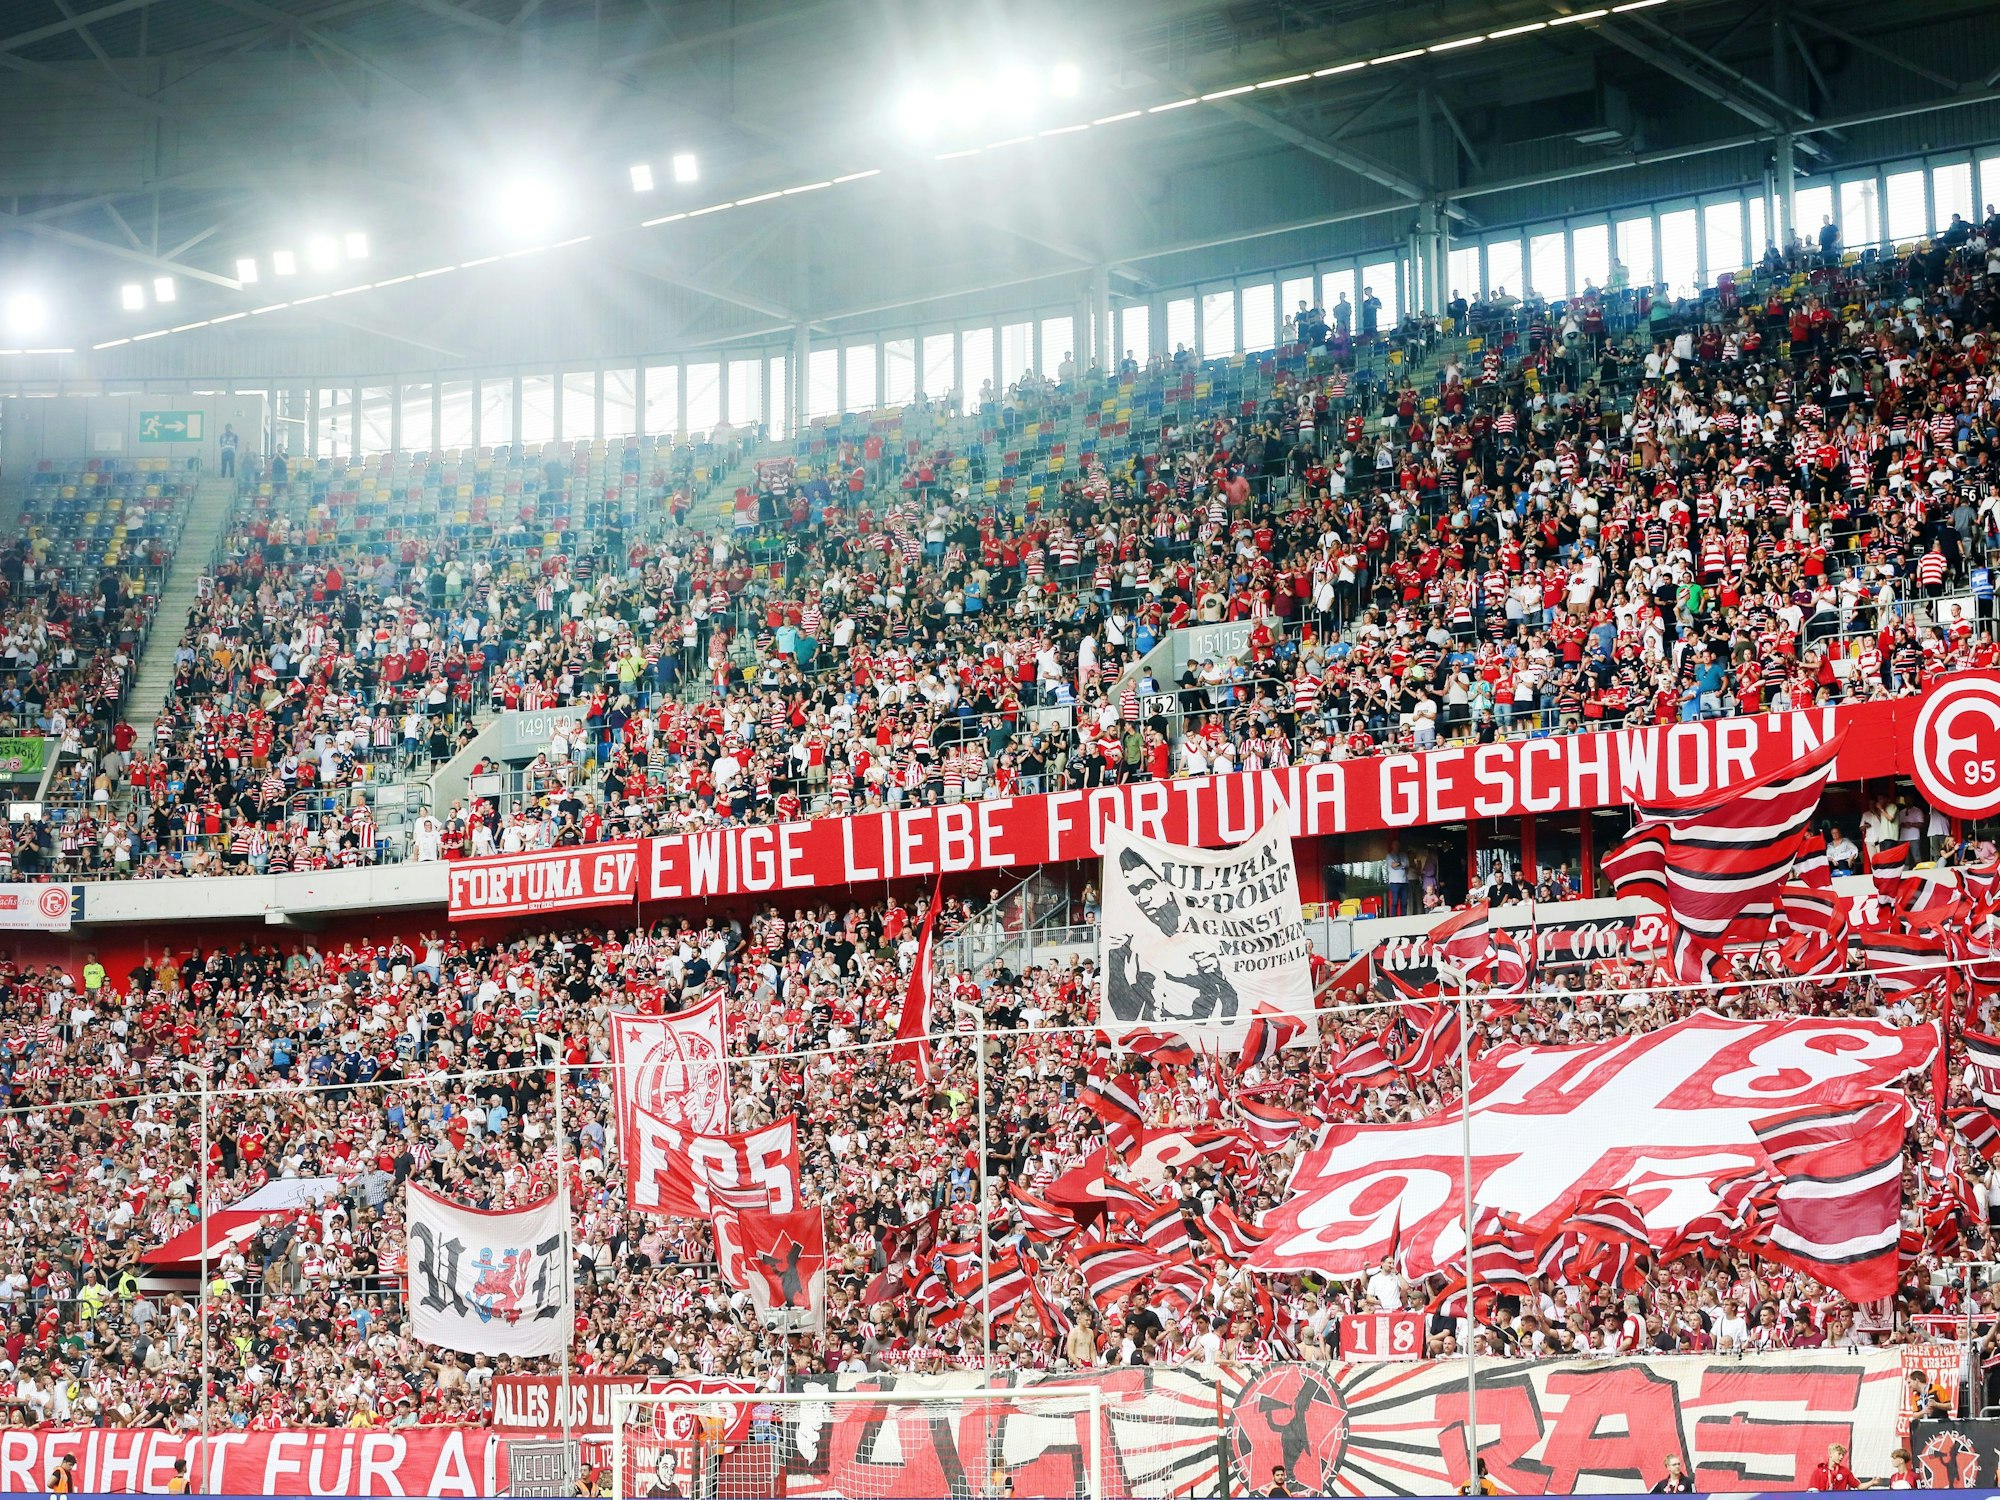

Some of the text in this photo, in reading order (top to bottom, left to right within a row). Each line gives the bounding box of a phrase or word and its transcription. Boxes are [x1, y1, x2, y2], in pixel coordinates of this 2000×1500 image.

[1961, 489, 1977, 502] 56
[1196, 629, 1248, 654] 151 152
[519, 715, 571, 737] 149 10
[1964, 760, 1996, 785] 95
[651, 822, 815, 900] EWIGE
[842, 800, 1015, 883] LIEBE
[1046, 763, 1346, 862] FORTUNA
[450, 852, 637, 909] FORTUNA GV
[1182, 907, 1284, 937] AGAINST
[1219, 919, 1306, 957] MODERN
[1570, 920, 1625, 961] 06
[493, 1383, 549, 1427] ALLES
[553, 1384, 588, 1427] AUS
[1925, 1430, 1974, 1448] ULTRAS
[262, 1431, 407, 1496] FÜR
[585, 1444, 628, 1468] ULTRS
